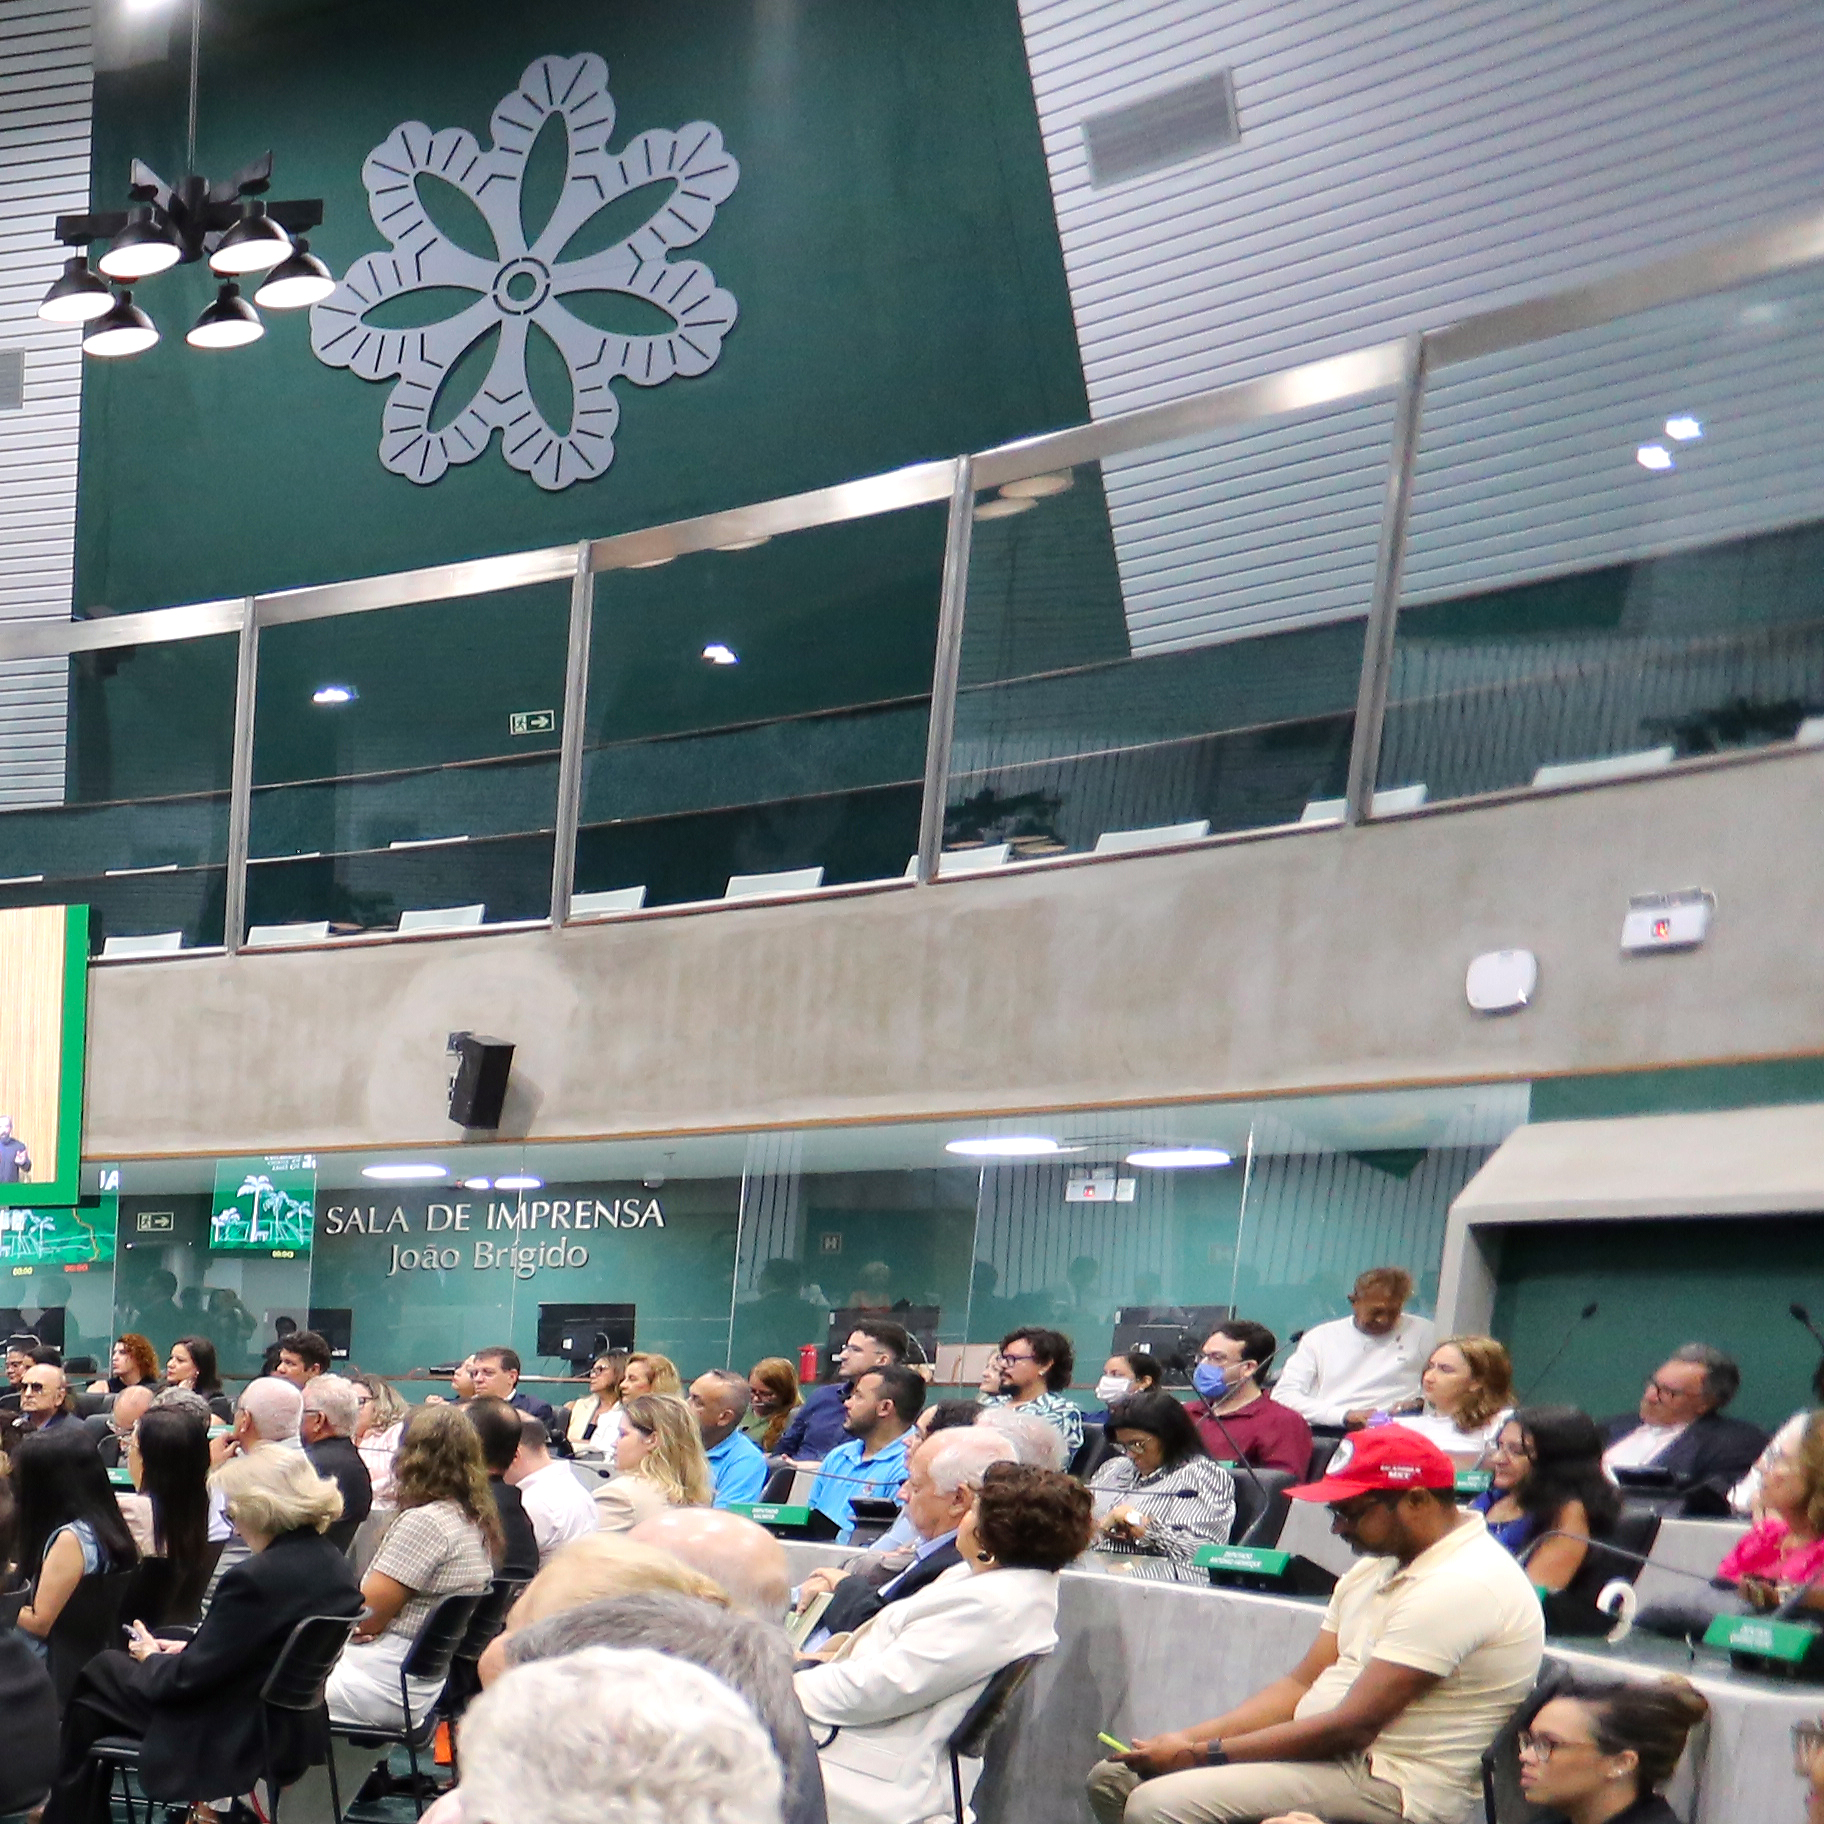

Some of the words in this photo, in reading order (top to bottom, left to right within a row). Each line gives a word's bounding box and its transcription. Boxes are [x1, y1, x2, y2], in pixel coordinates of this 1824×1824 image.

[326, 1205, 410, 1234] SALA
[426, 1203, 472, 1232] DE
[486, 1198, 666, 1231] IMPRENSA
[386, 1243, 460, 1277] João
[473, 1236, 589, 1279] Brígido
